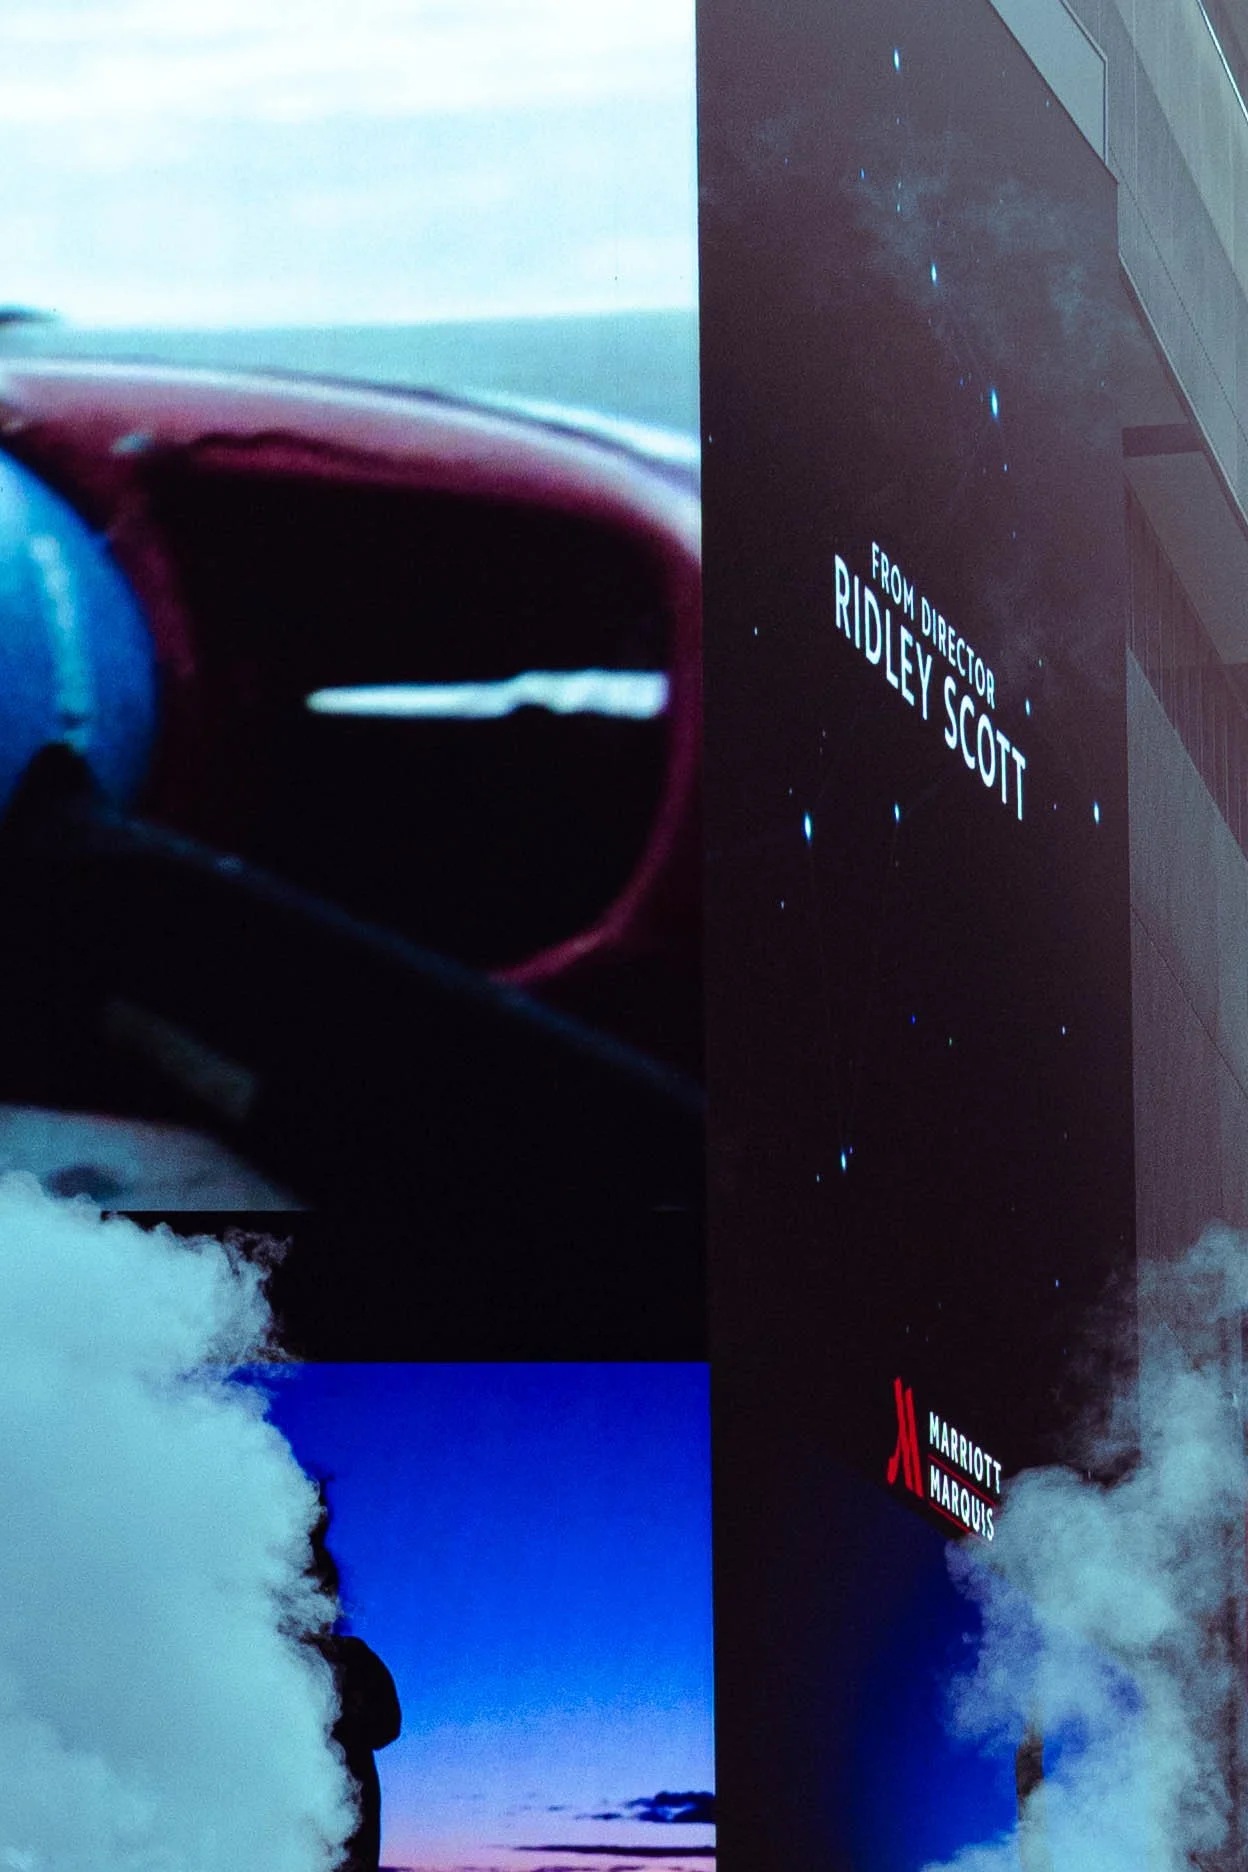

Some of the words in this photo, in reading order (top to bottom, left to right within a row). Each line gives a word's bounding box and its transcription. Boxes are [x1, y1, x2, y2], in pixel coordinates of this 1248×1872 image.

[835, 553, 932, 720] RIDLEY
[943, 675, 1026, 820] SCOTT
[872, 541, 914, 620] FROM
[921, 596, 995, 709] DIRECTOR
[928, 1410, 1002, 1495] MARRIOTT
[929, 1465, 995, 1542] MARQUIS
